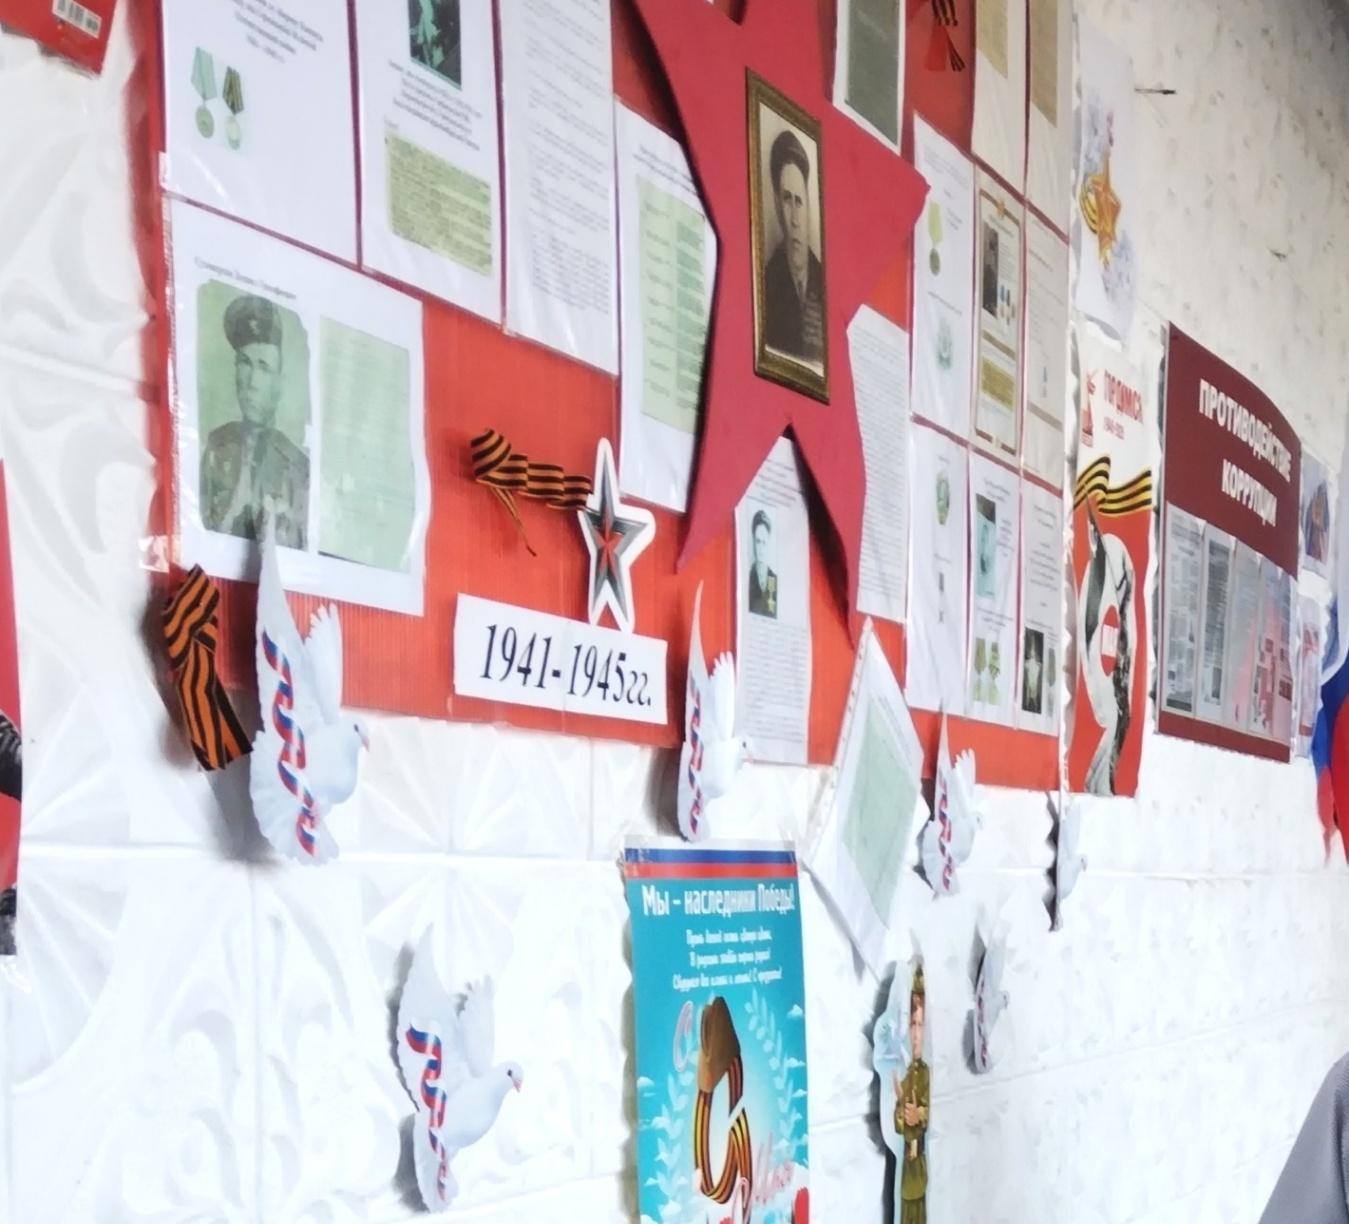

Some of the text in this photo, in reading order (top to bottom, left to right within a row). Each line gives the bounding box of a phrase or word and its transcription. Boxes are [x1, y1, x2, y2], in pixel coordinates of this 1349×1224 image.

[1199, 377, 1292, 483] ПРОТИВОДЕЙСТВИЕ
[1221, 458, 1277, 528] КОРРУПЦИИ
[641, 884, 670, 916] Мы
[684, 889, 756, 918] наследники
[757, 883, 795, 915] Победы!
